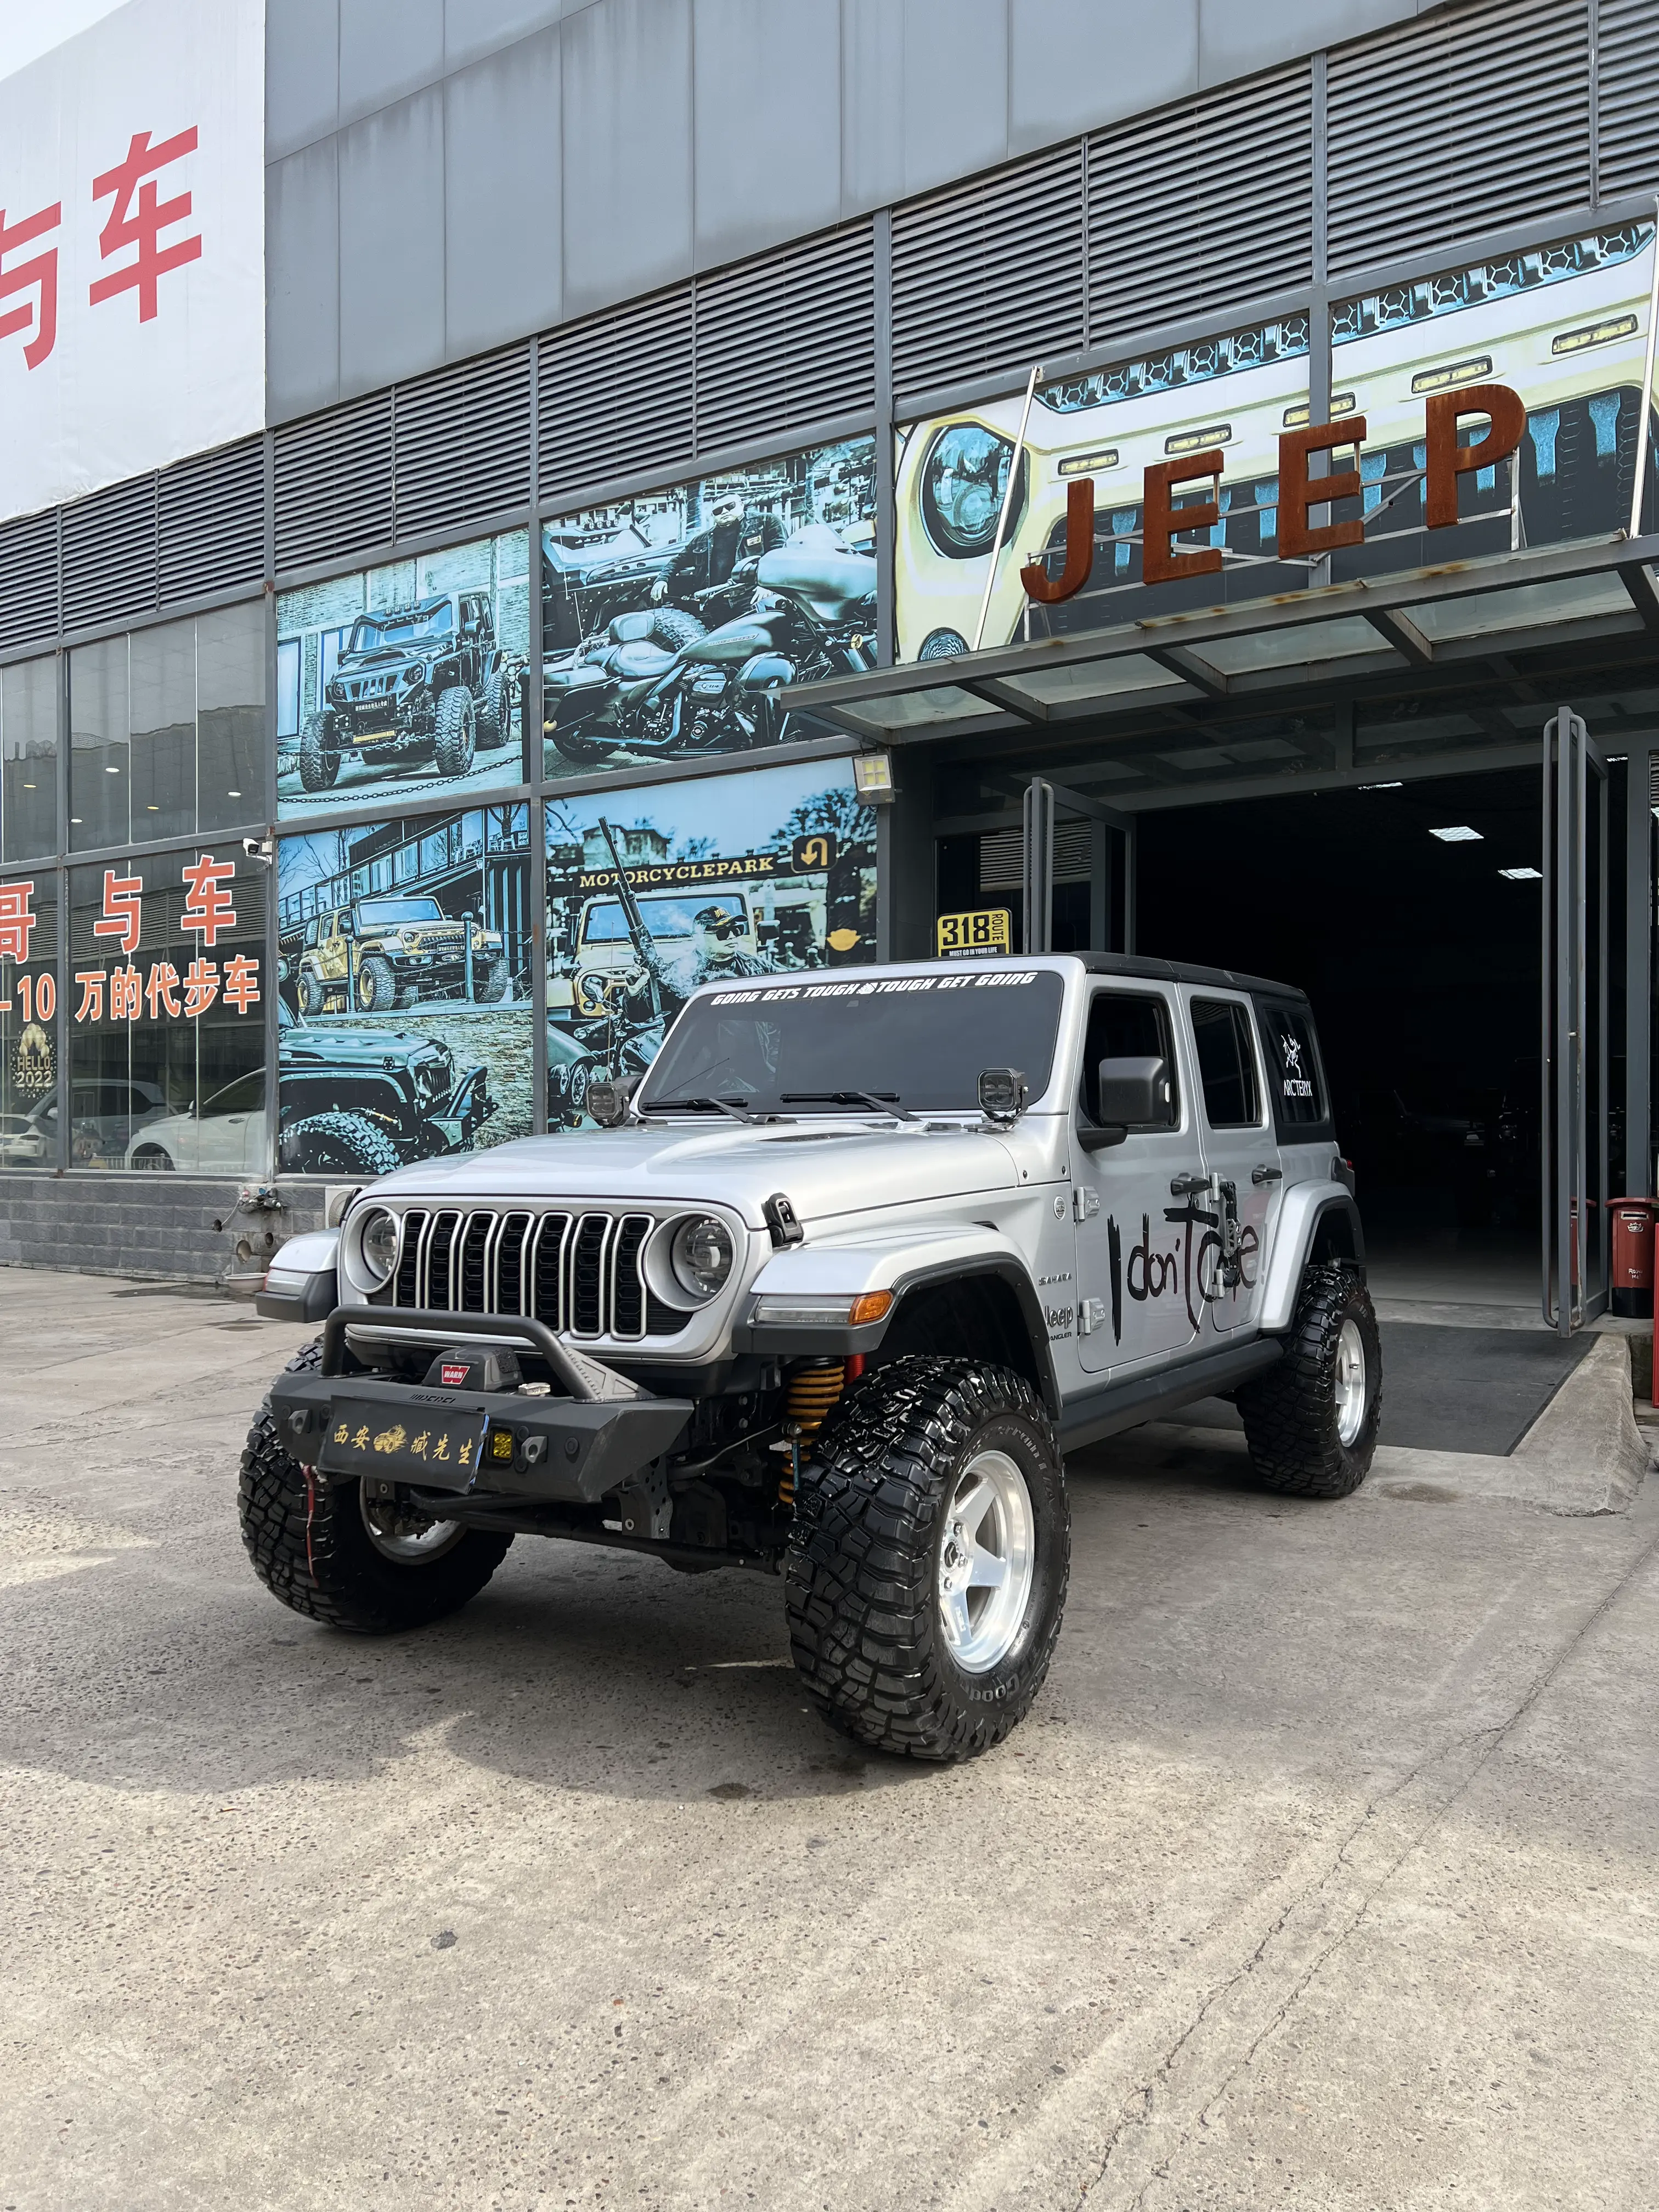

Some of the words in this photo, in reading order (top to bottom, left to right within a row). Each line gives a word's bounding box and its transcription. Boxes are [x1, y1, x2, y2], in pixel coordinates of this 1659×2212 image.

[1020, 384, 1526, 604] JEEP
[579, 857, 774, 888] MOTORCYCLEPARK
[943, 915, 990, 946] 318
[992, 913, 1003, 941] ROUTE
[710, 994, 760, 1006] GOING
[761, 988, 801, 1001] GETS
[803, 983, 860, 998] TOUGH
[876, 978, 933, 993] TOUGH
[939, 975, 977, 989] GET
[975, 972, 1038, 986] GOING
[17, 1056, 51, 1071] HELLO
[16, 1070, 54, 1088] 2022
[1284, 1079, 1312, 1096] ARC'TERYX
[1039, 1272, 1072, 1286] SAHARA
[1107, 1214, 1122, 1346] I
[1198, 1224, 1260, 1302] Ce
[1045, 1305, 1073, 1329] Jeep
[1050, 1331, 1072, 1341] ANGLER
[444, 1370, 464, 1379] WARN
[334, 1424, 370, 1451] 西安
